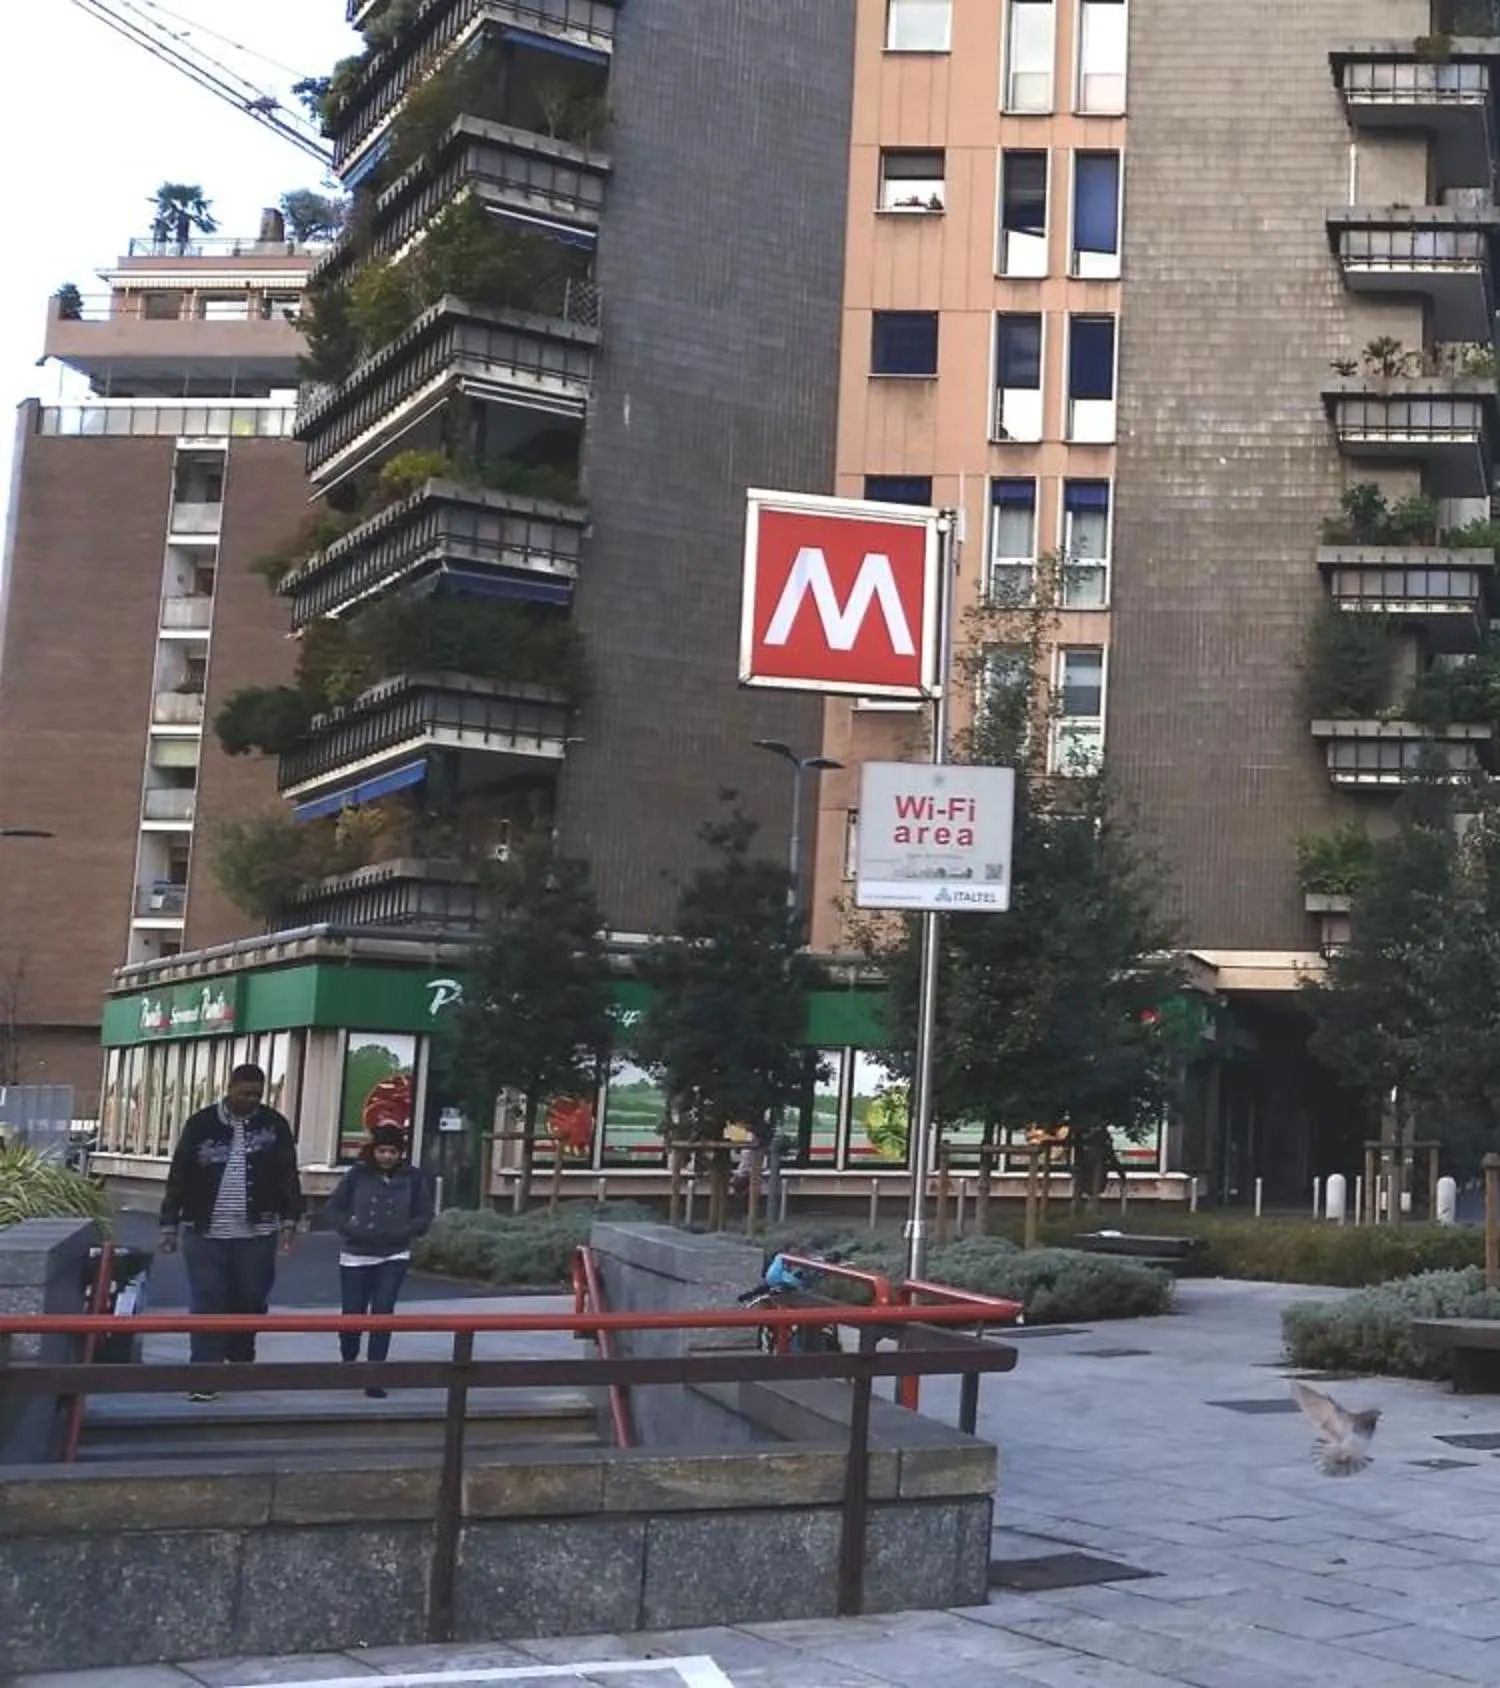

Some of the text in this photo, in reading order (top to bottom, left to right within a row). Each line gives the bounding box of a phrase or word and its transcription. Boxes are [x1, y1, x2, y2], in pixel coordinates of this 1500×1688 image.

[763, 547, 916, 655] M
[895, 795, 975, 821] Wi-Fi
[894, 825, 973, 846] area
